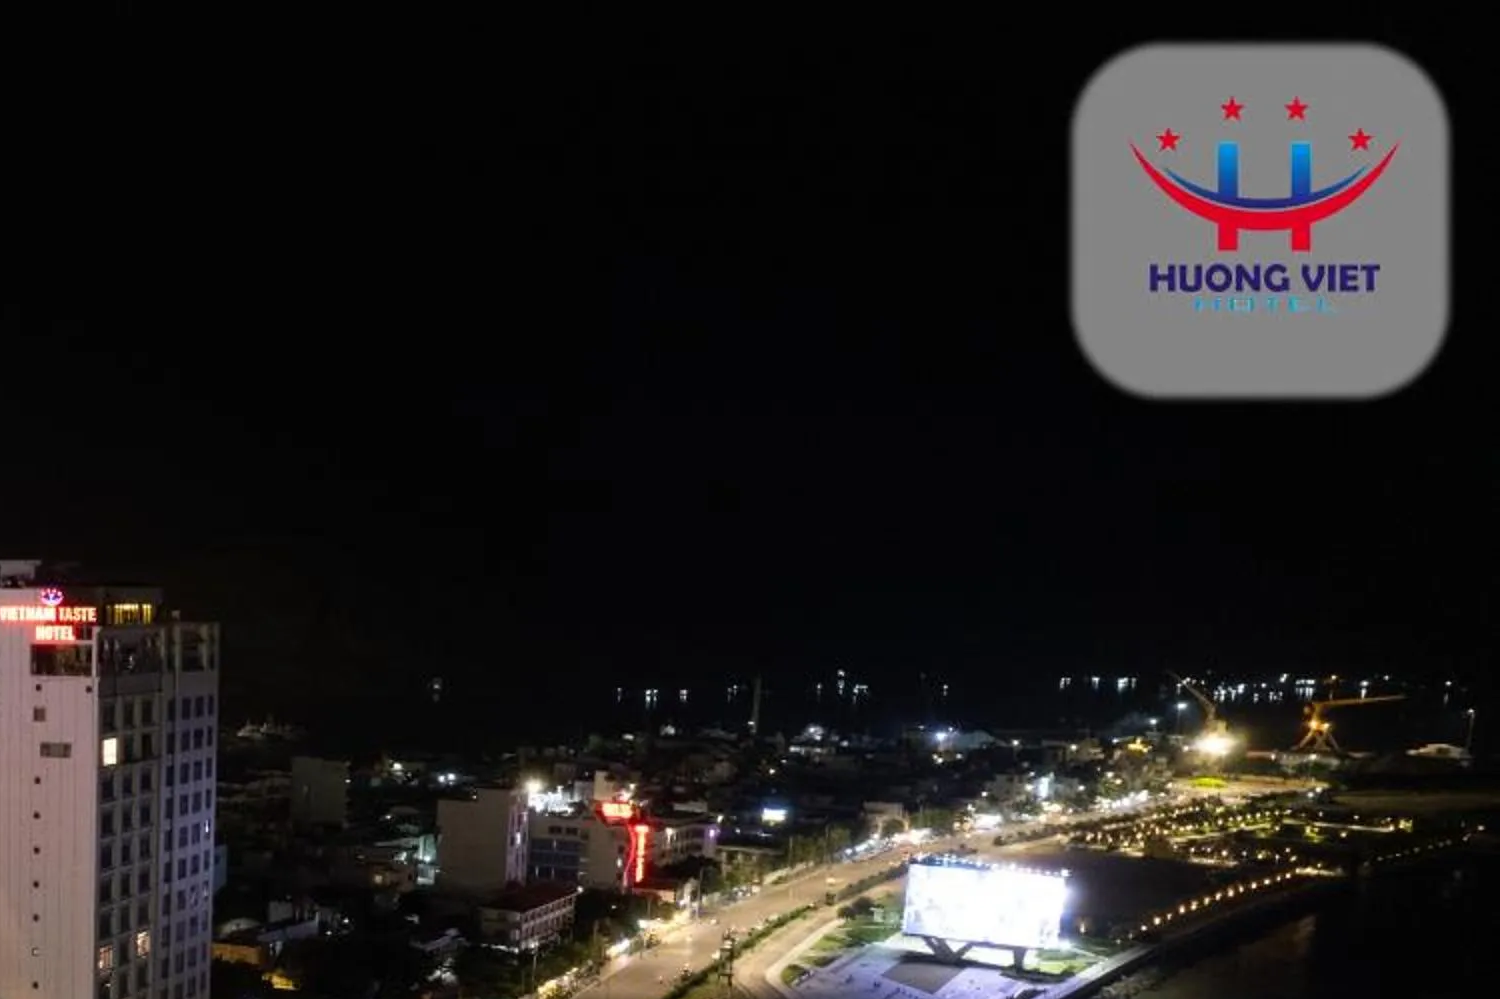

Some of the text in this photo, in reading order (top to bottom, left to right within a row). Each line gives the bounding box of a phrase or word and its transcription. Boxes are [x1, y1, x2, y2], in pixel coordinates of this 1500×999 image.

[0, 606, 97, 622] VIETNAM TASTE
[36, 625, 75, 640] HOTEL
